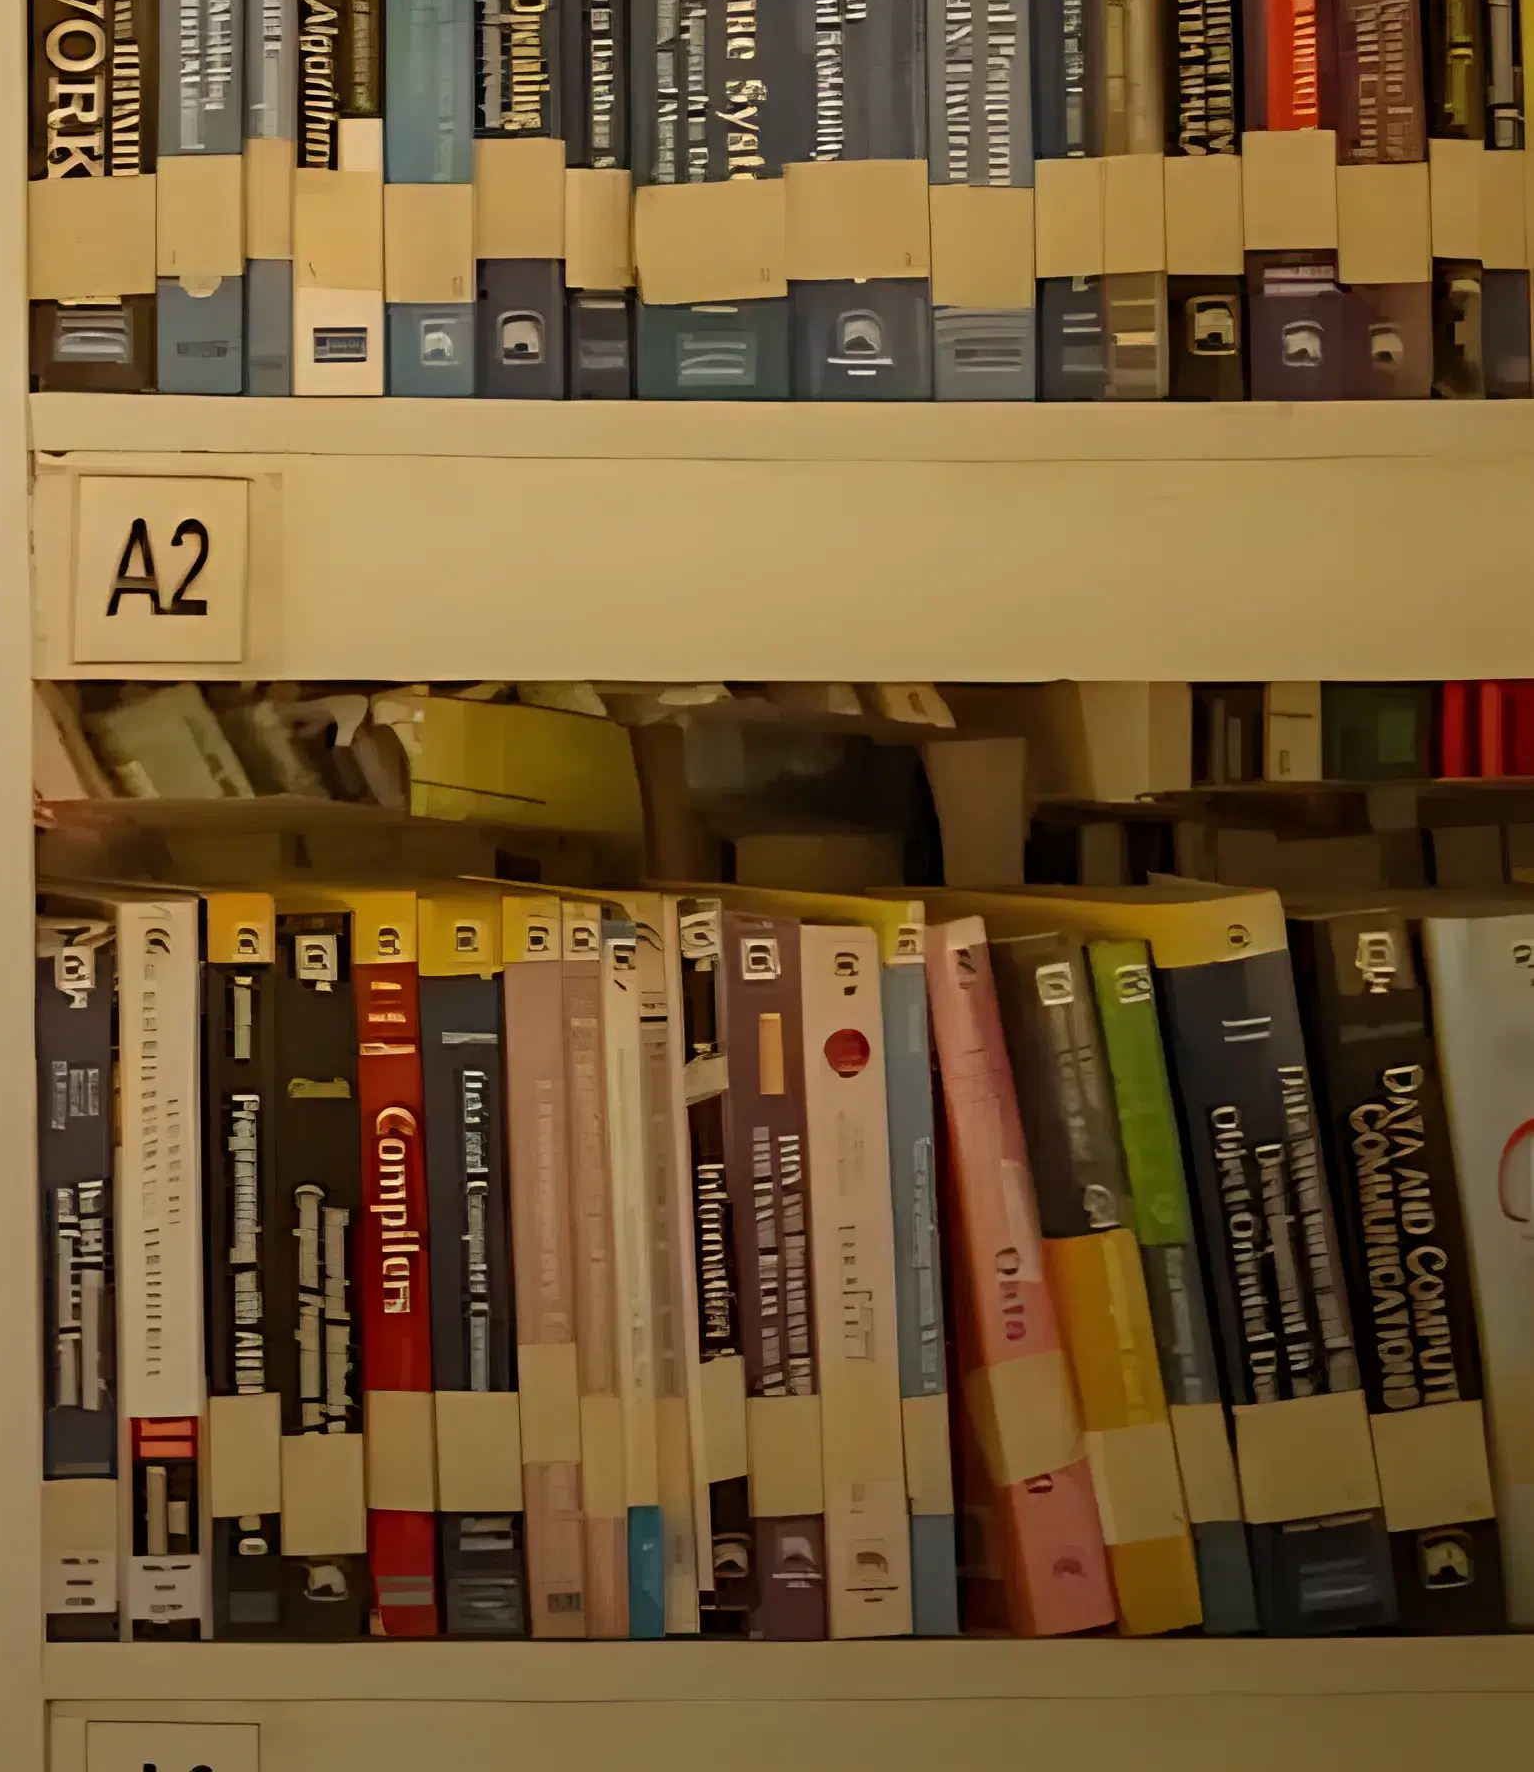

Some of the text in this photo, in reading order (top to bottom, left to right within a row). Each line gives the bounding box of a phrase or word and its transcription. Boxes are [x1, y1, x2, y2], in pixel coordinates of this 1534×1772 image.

[106, 518, 210, 617] A2
[1382, 1065, 1426, 1161] DATA
[370, 1106, 421, 1314] Compilers
